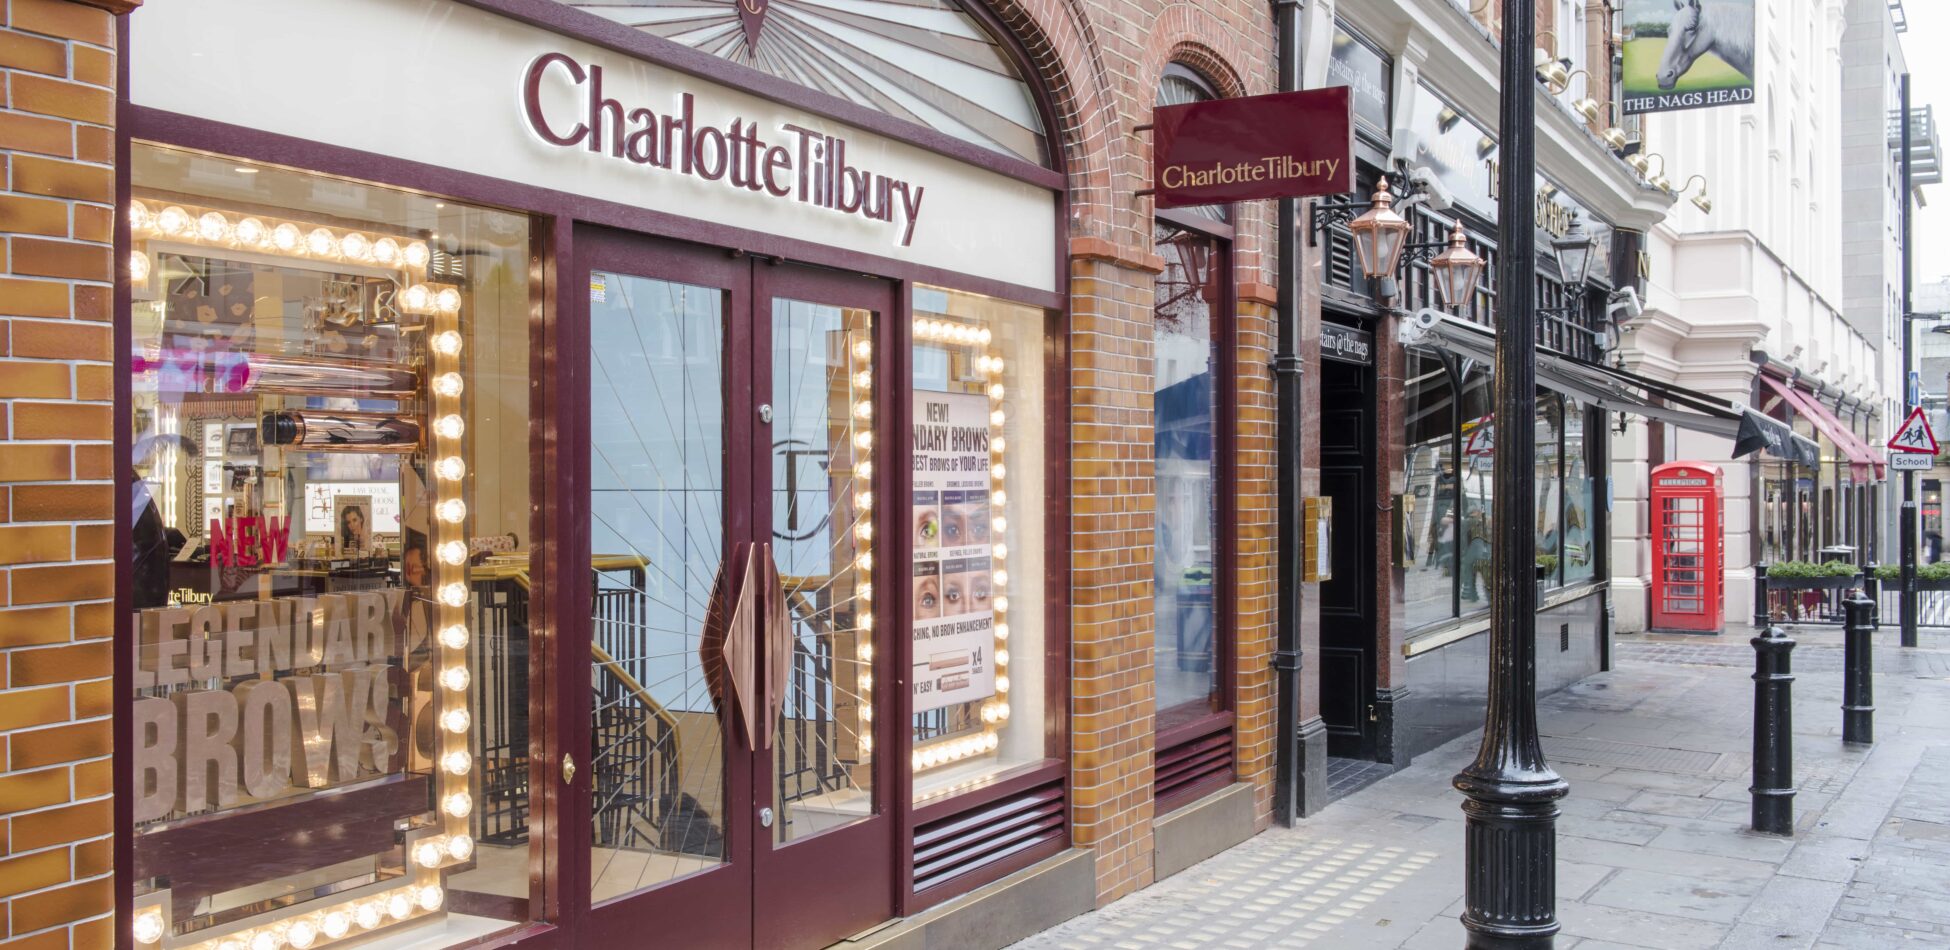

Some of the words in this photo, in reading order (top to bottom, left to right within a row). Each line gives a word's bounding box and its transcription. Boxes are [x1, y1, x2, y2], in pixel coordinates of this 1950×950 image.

[1623, 97, 1655, 111] THE
[1658, 92, 1703, 108] NAGS
[1706, 87, 1753, 104] HEAD
[522, 52, 925, 247] CharlotteTilbury
[1162, 155, 1340, 189] CharlotteTilbury
[1343, 332, 1354, 353] the
[1355, 340, 1368, 360] nags
[926, 402, 949, 423] NEW!
[952, 426, 989, 452] BROWS
[929, 457, 951, 472] BROWS
[951, 458, 959, 472] OF
[959, 456, 977, 472] YOUR
[977, 458, 989, 472] LIFE
[1896, 457, 1929, 466] School
[210, 516, 291, 569] NEW
[132, 589, 408, 690] LEGENDARY
[932, 626, 940, 638] NO
[940, 623, 956, 637] BROW
[956, 617, 993, 635] ENHANCEMENT
[920, 680, 933, 694] EASY
[132, 663, 398, 823] BROWS
